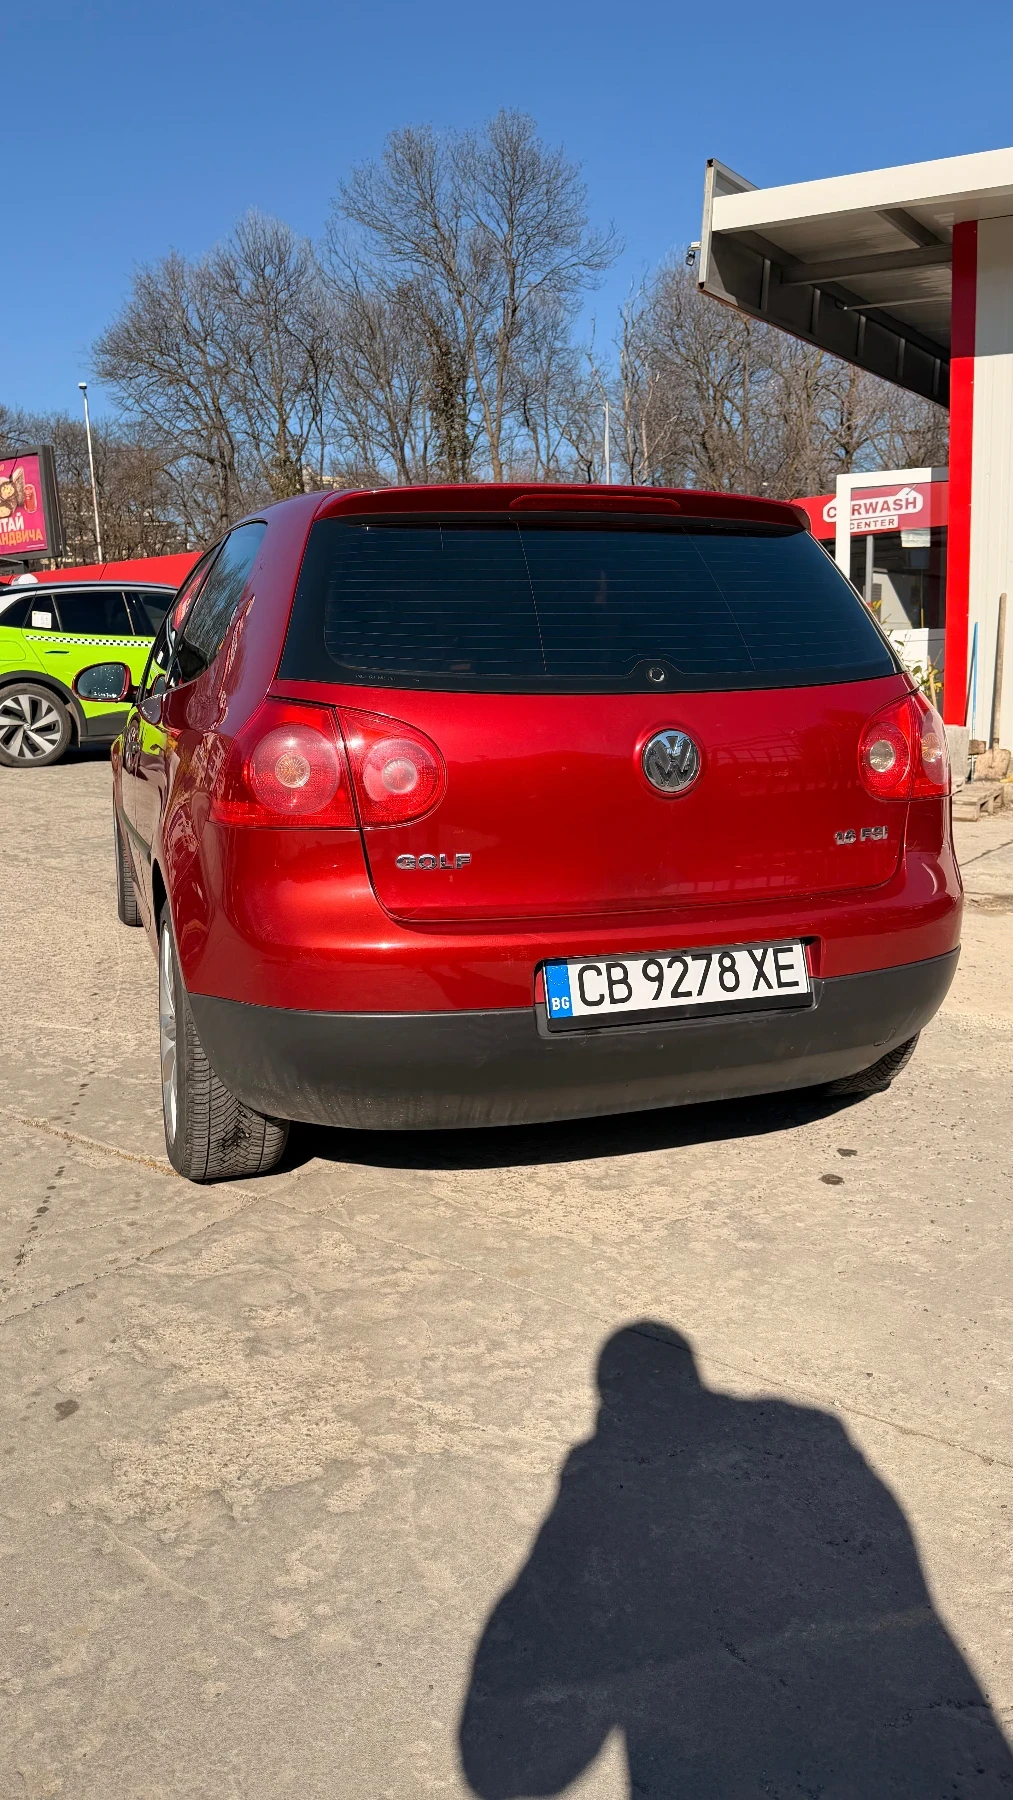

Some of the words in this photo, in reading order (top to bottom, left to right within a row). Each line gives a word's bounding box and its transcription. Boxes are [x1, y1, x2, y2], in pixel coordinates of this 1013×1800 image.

[826, 496, 917, 519] CRWASH
[850, 518, 895, 530] CENTER
[860, 825, 888, 841] FSI
[396, 853, 471, 870] GOLF
[577, 961, 633, 1007] CB
[641, 951, 741, 1001] 9278
[748, 946, 799, 991] XE
[552, 997, 570, 1010] BG
